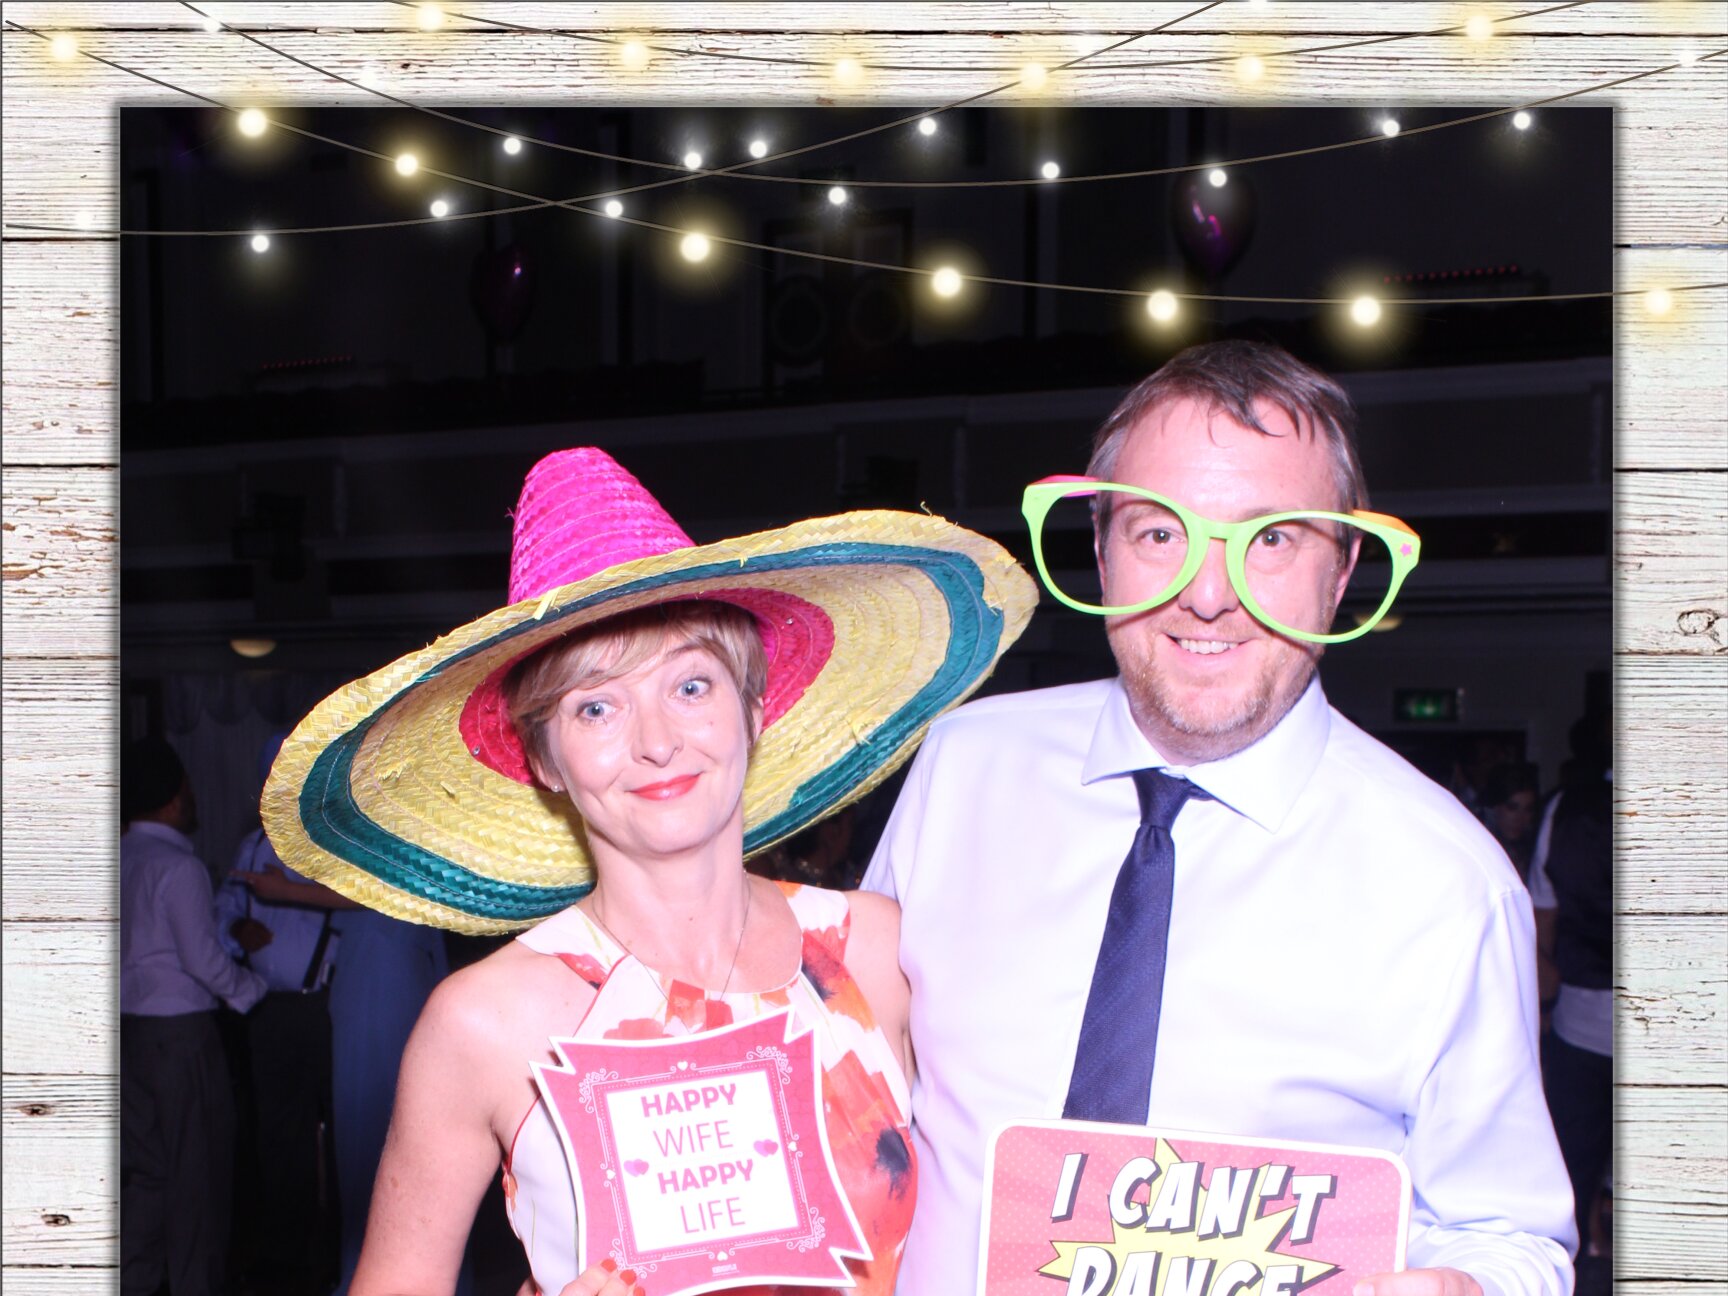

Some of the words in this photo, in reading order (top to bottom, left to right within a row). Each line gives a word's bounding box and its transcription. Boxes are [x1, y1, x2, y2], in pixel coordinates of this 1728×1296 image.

[641, 1083, 737, 1117] HAPPY
[653, 1119, 734, 1157] WIFE
[657, 1159, 754, 1194] HAPPY
[680, 1196, 746, 1234] LIFE
[1051, 1153, 1088, 1222] I
[1108, 1157, 1337, 1244] CAN'T
